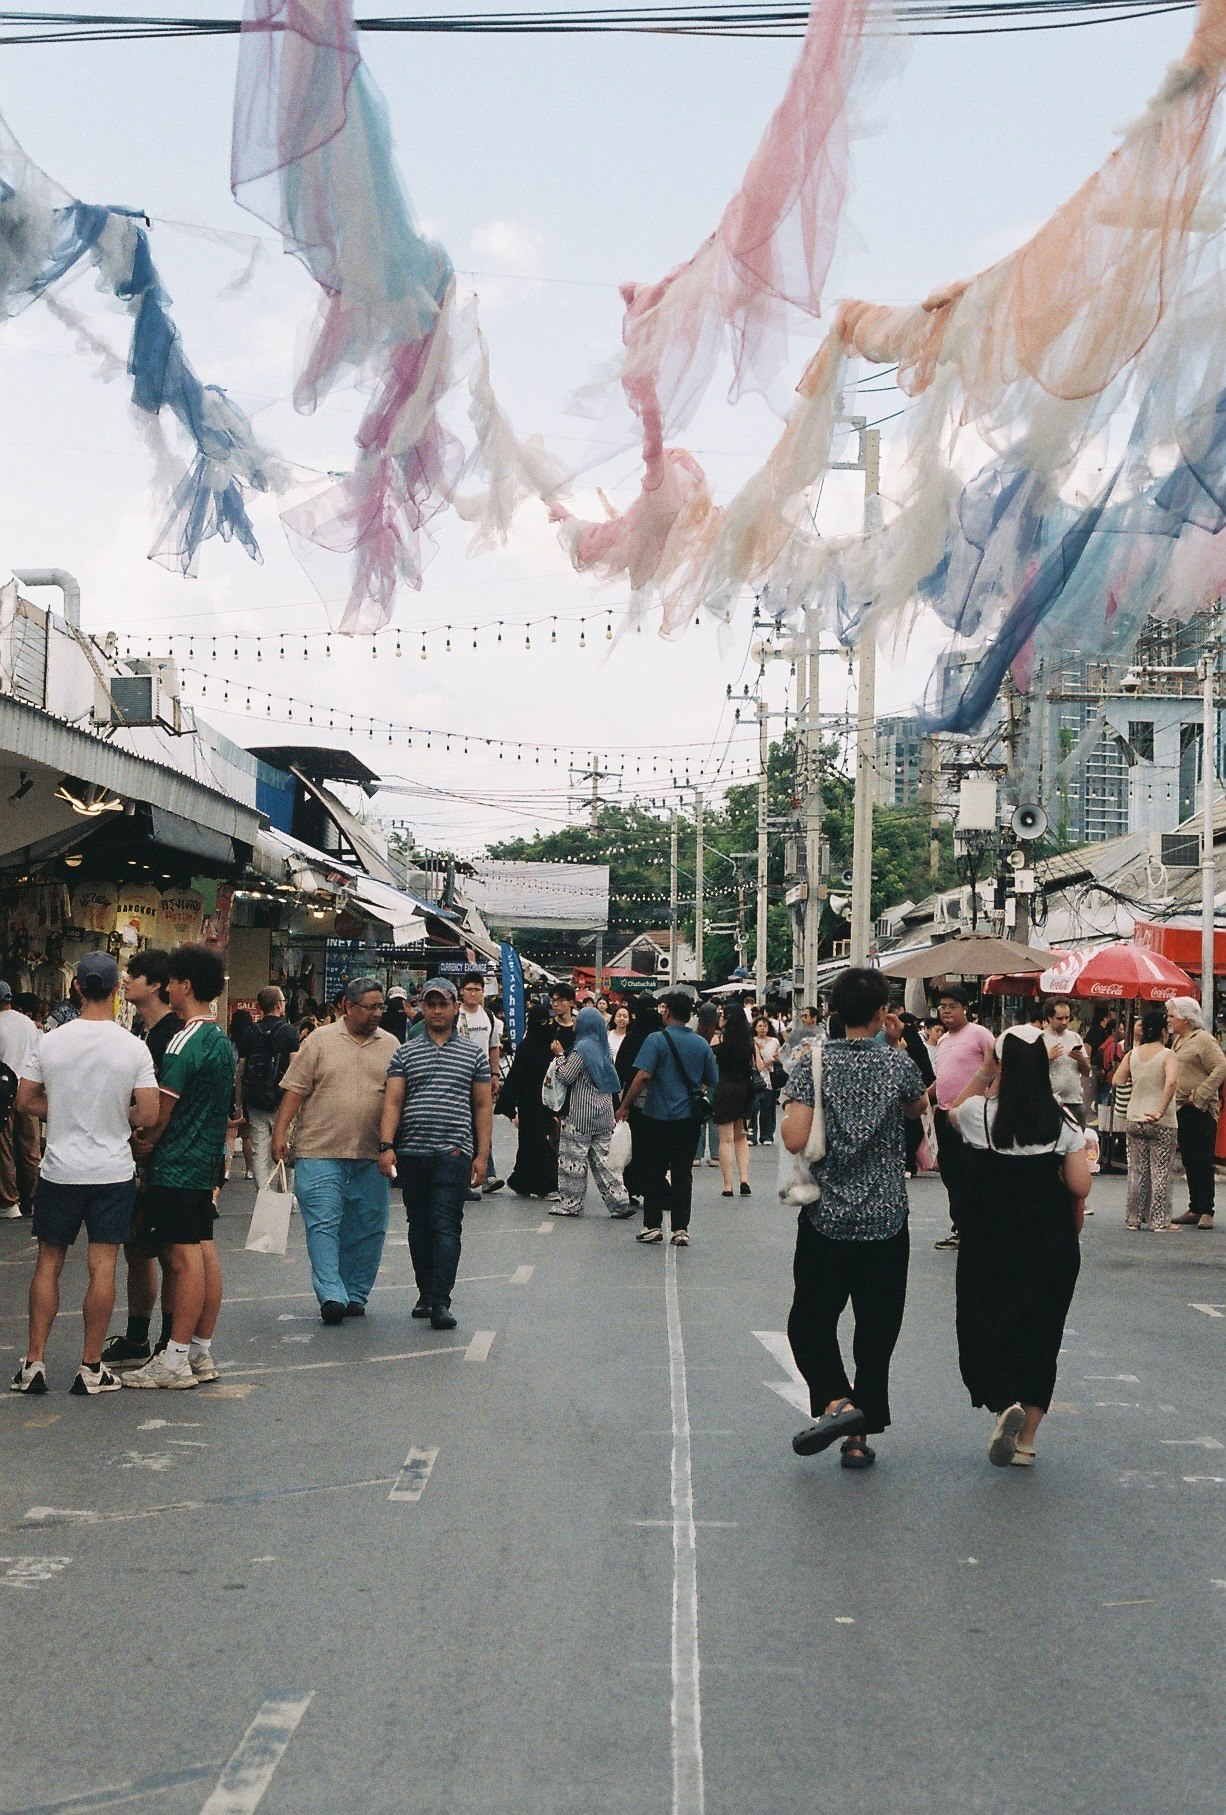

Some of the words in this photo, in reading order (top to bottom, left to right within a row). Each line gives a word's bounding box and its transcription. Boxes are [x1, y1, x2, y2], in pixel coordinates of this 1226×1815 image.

[117, 904, 157, 917] BANGKOK
[1091, 982, 1124, 996] Coca-Cola
[237, 1002, 257, 1010] SALE
